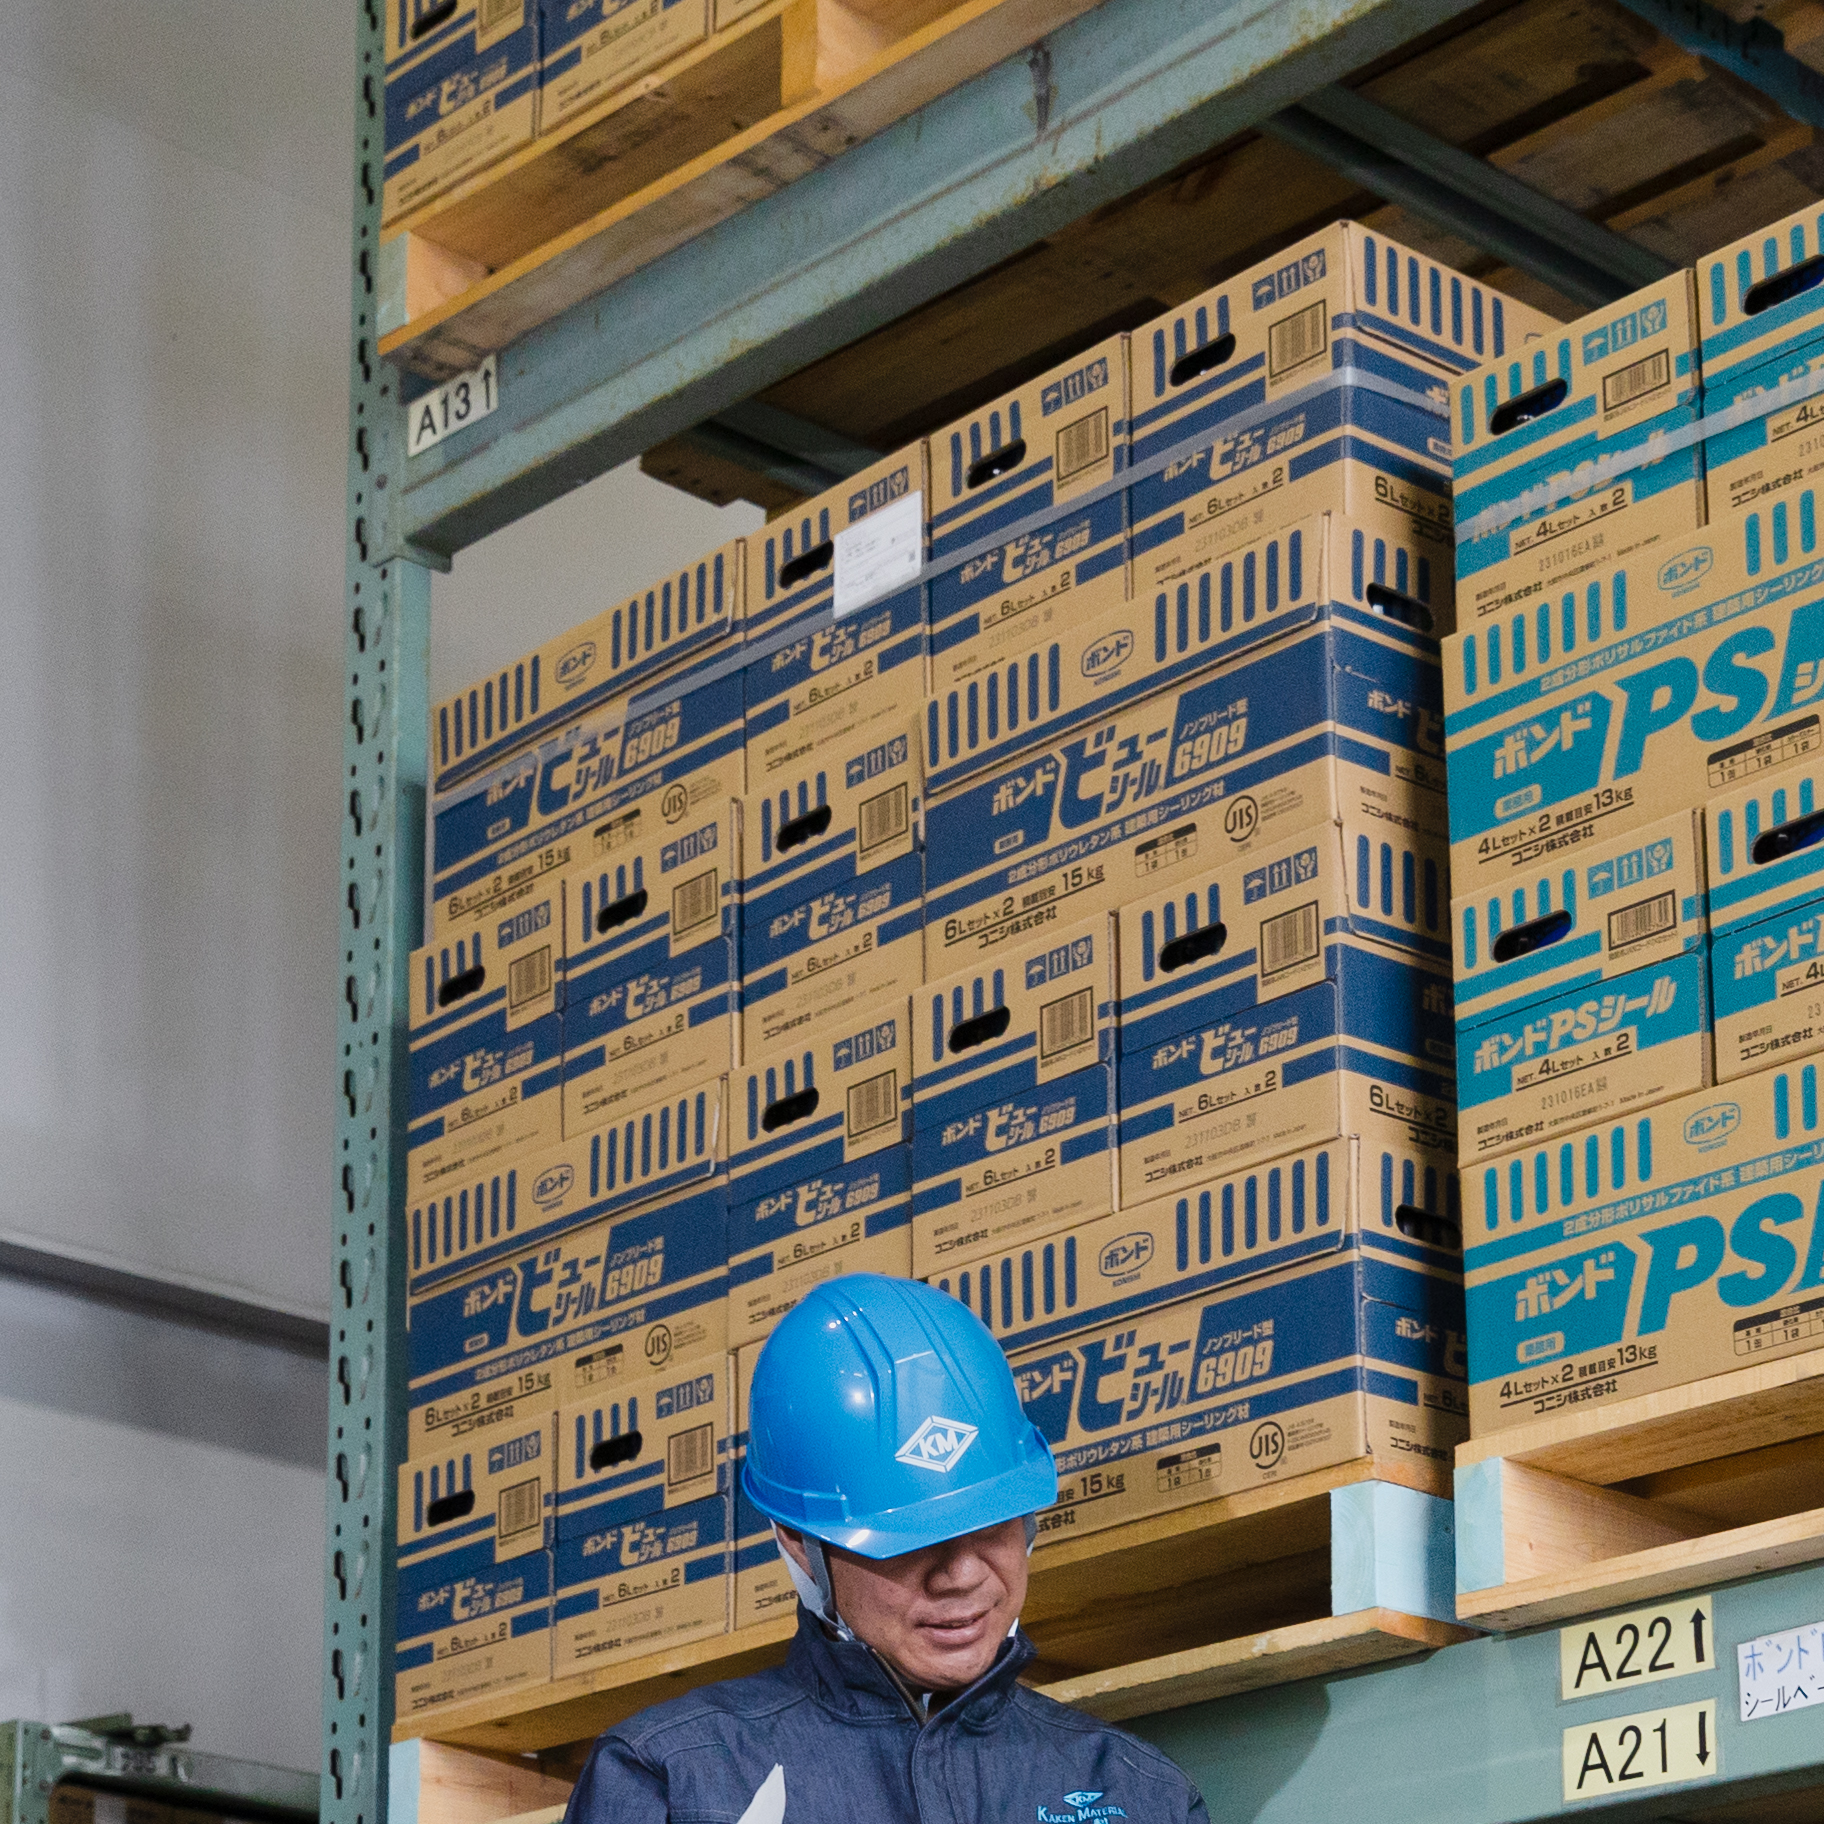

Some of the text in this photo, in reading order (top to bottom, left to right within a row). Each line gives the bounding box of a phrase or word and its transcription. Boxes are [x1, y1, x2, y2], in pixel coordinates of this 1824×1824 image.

[417, 383, 471, 445] A13
[1174, 718, 1248, 780] 6909
[992, 761, 1056, 816] ボンド
[605, 1254, 664, 1301] 6909
[1514, 1251, 1615, 1322] ボンド
[1636, 1192, 1804, 1338] PS
[1197, 1339, 1275, 1394] 6909
[1080, 1472, 1102, 1496] 15
[1574, 1617, 1674, 1689] A22
[1576, 1719, 1667, 1790] A21
